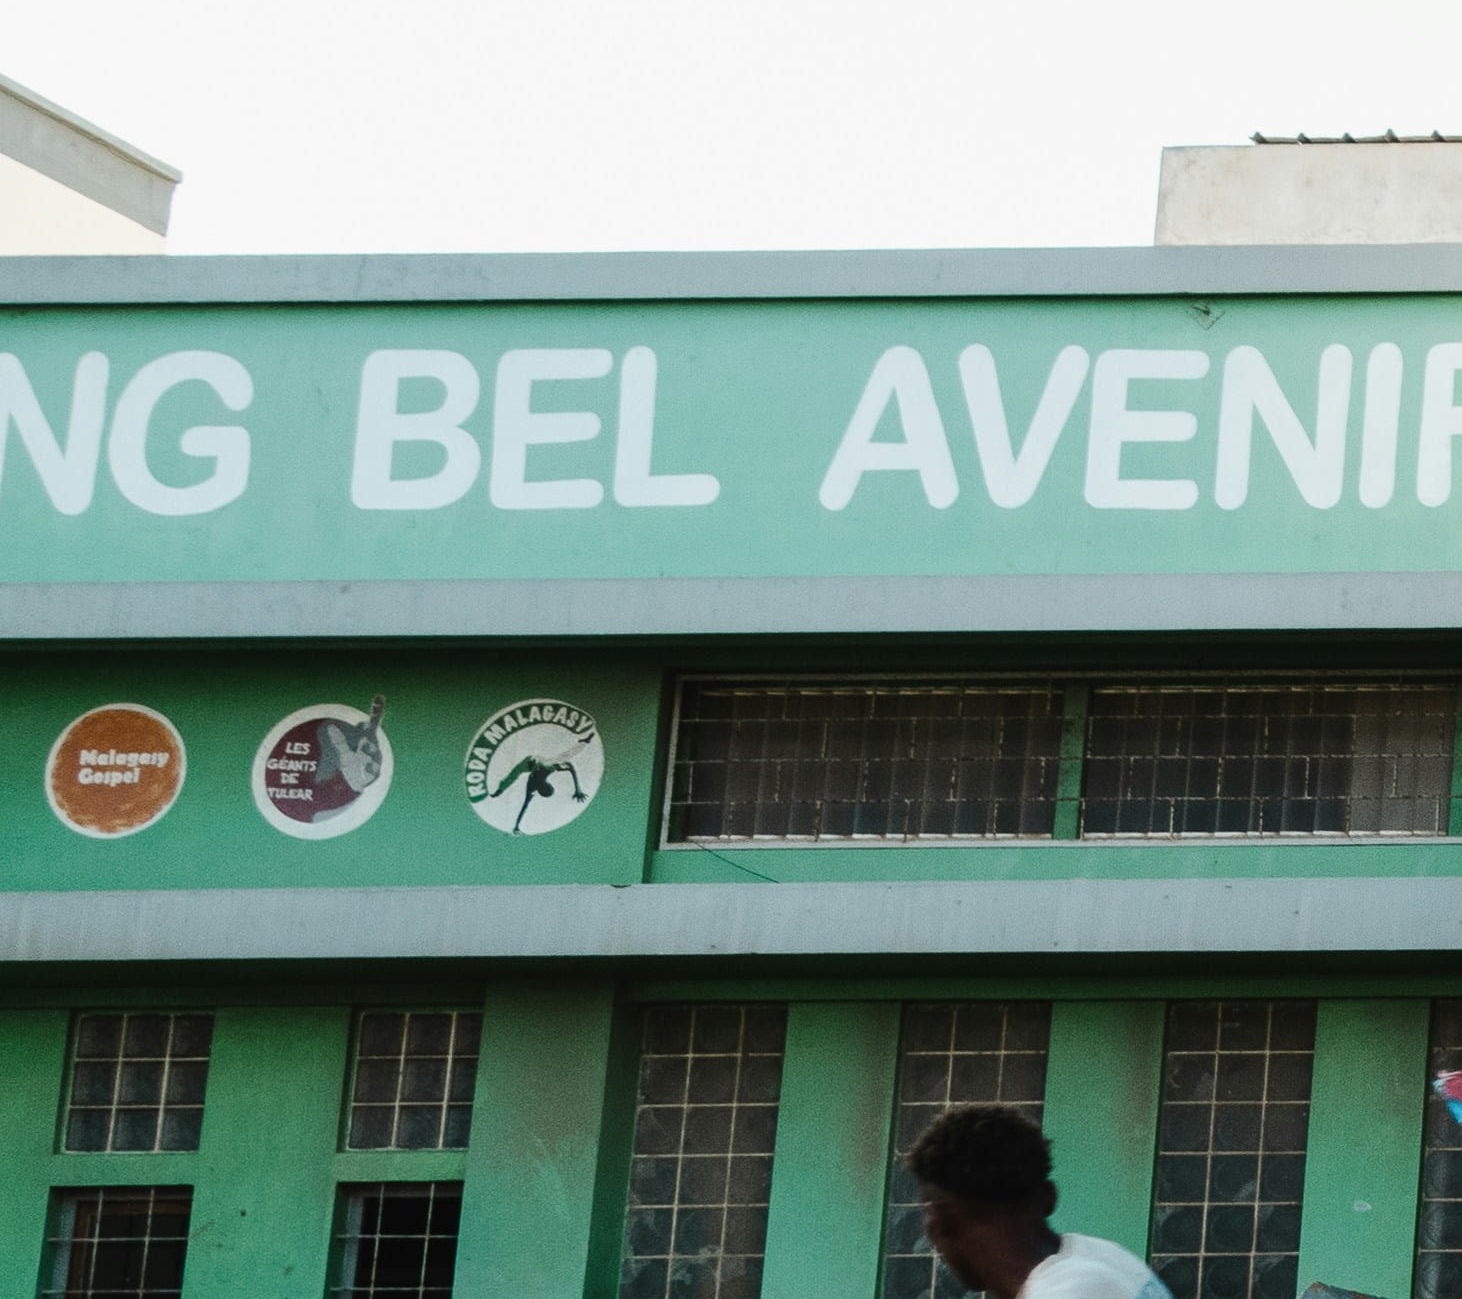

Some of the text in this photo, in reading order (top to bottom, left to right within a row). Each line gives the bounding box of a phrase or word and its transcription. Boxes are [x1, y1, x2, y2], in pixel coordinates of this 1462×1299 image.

[0, 350, 254, 516] NG
[350, 346, 721, 511] BEL
[285, 740, 312, 756] LES
[466, 704, 594, 799] RODA MALAGASY
[79, 748, 170, 769] Malagasy
[78, 767, 141, 787] Gospel
[280, 771, 300, 785] DE
